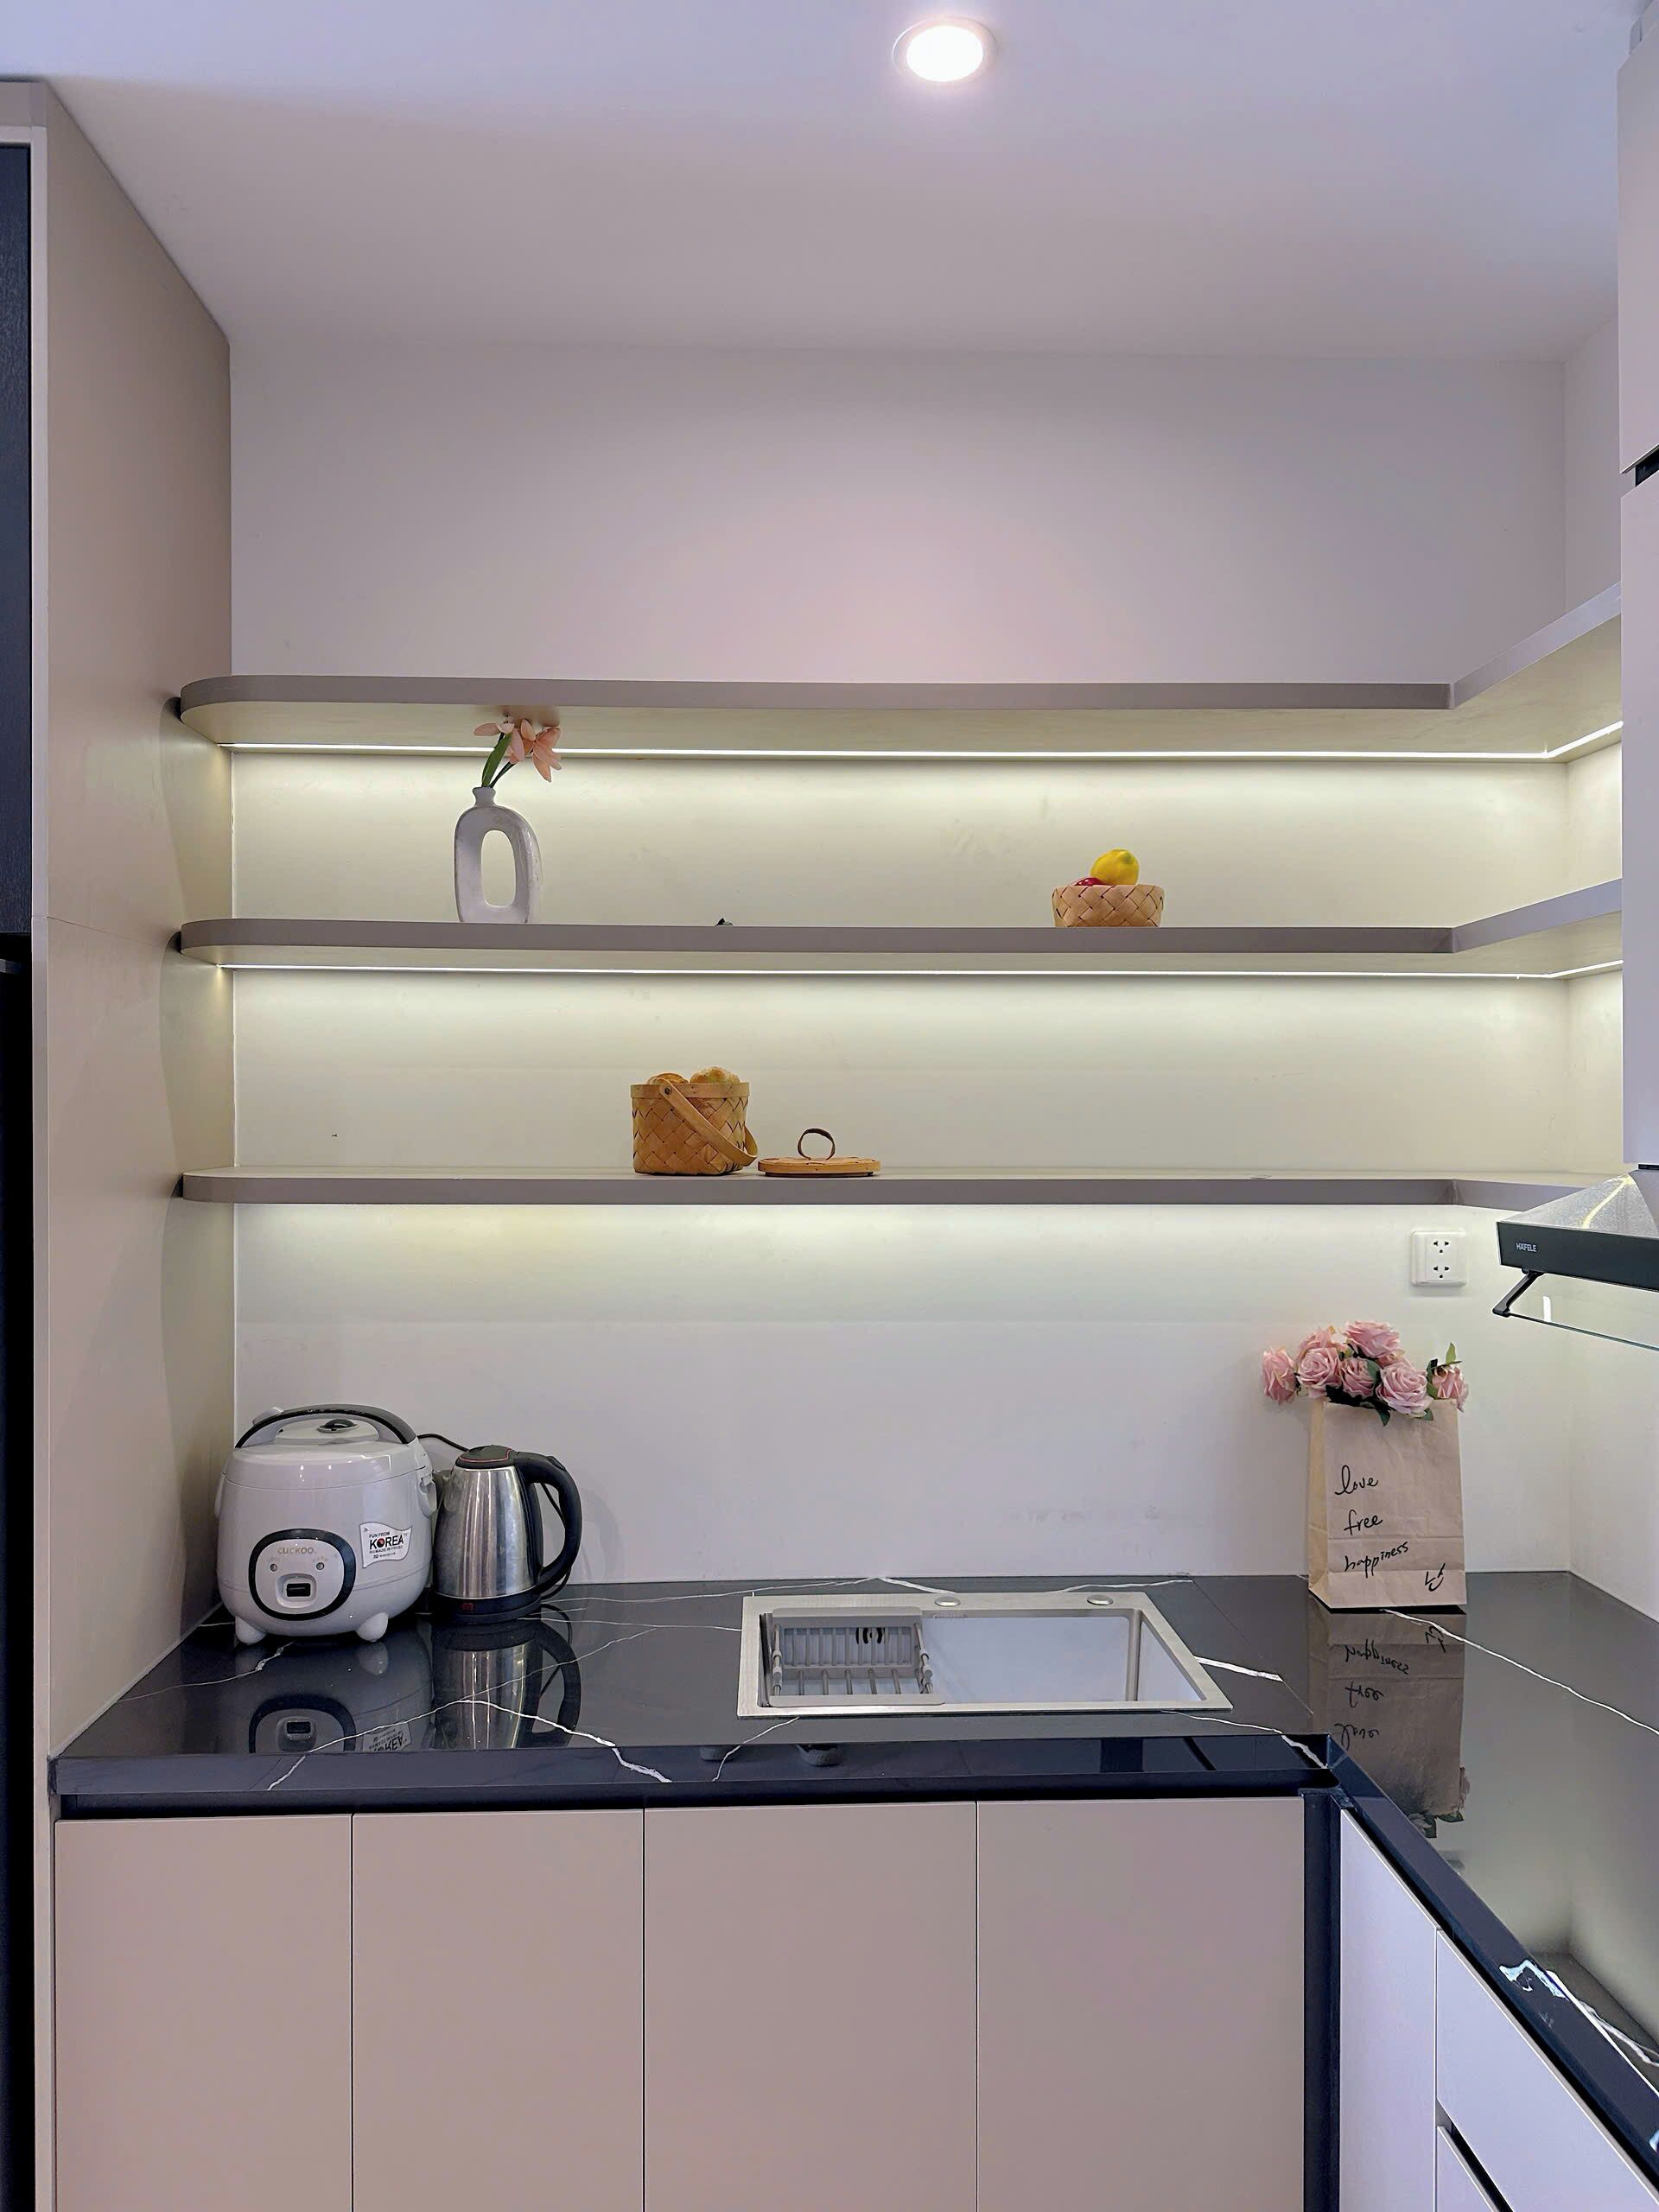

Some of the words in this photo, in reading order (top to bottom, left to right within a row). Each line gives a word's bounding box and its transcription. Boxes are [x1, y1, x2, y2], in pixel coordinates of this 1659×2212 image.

[1334, 1465, 1378, 1495] love
[1344, 1510, 1382, 1535] free
[370, 1535, 404, 1549] KOREA
[1344, 1541, 1408, 1579] happiness
